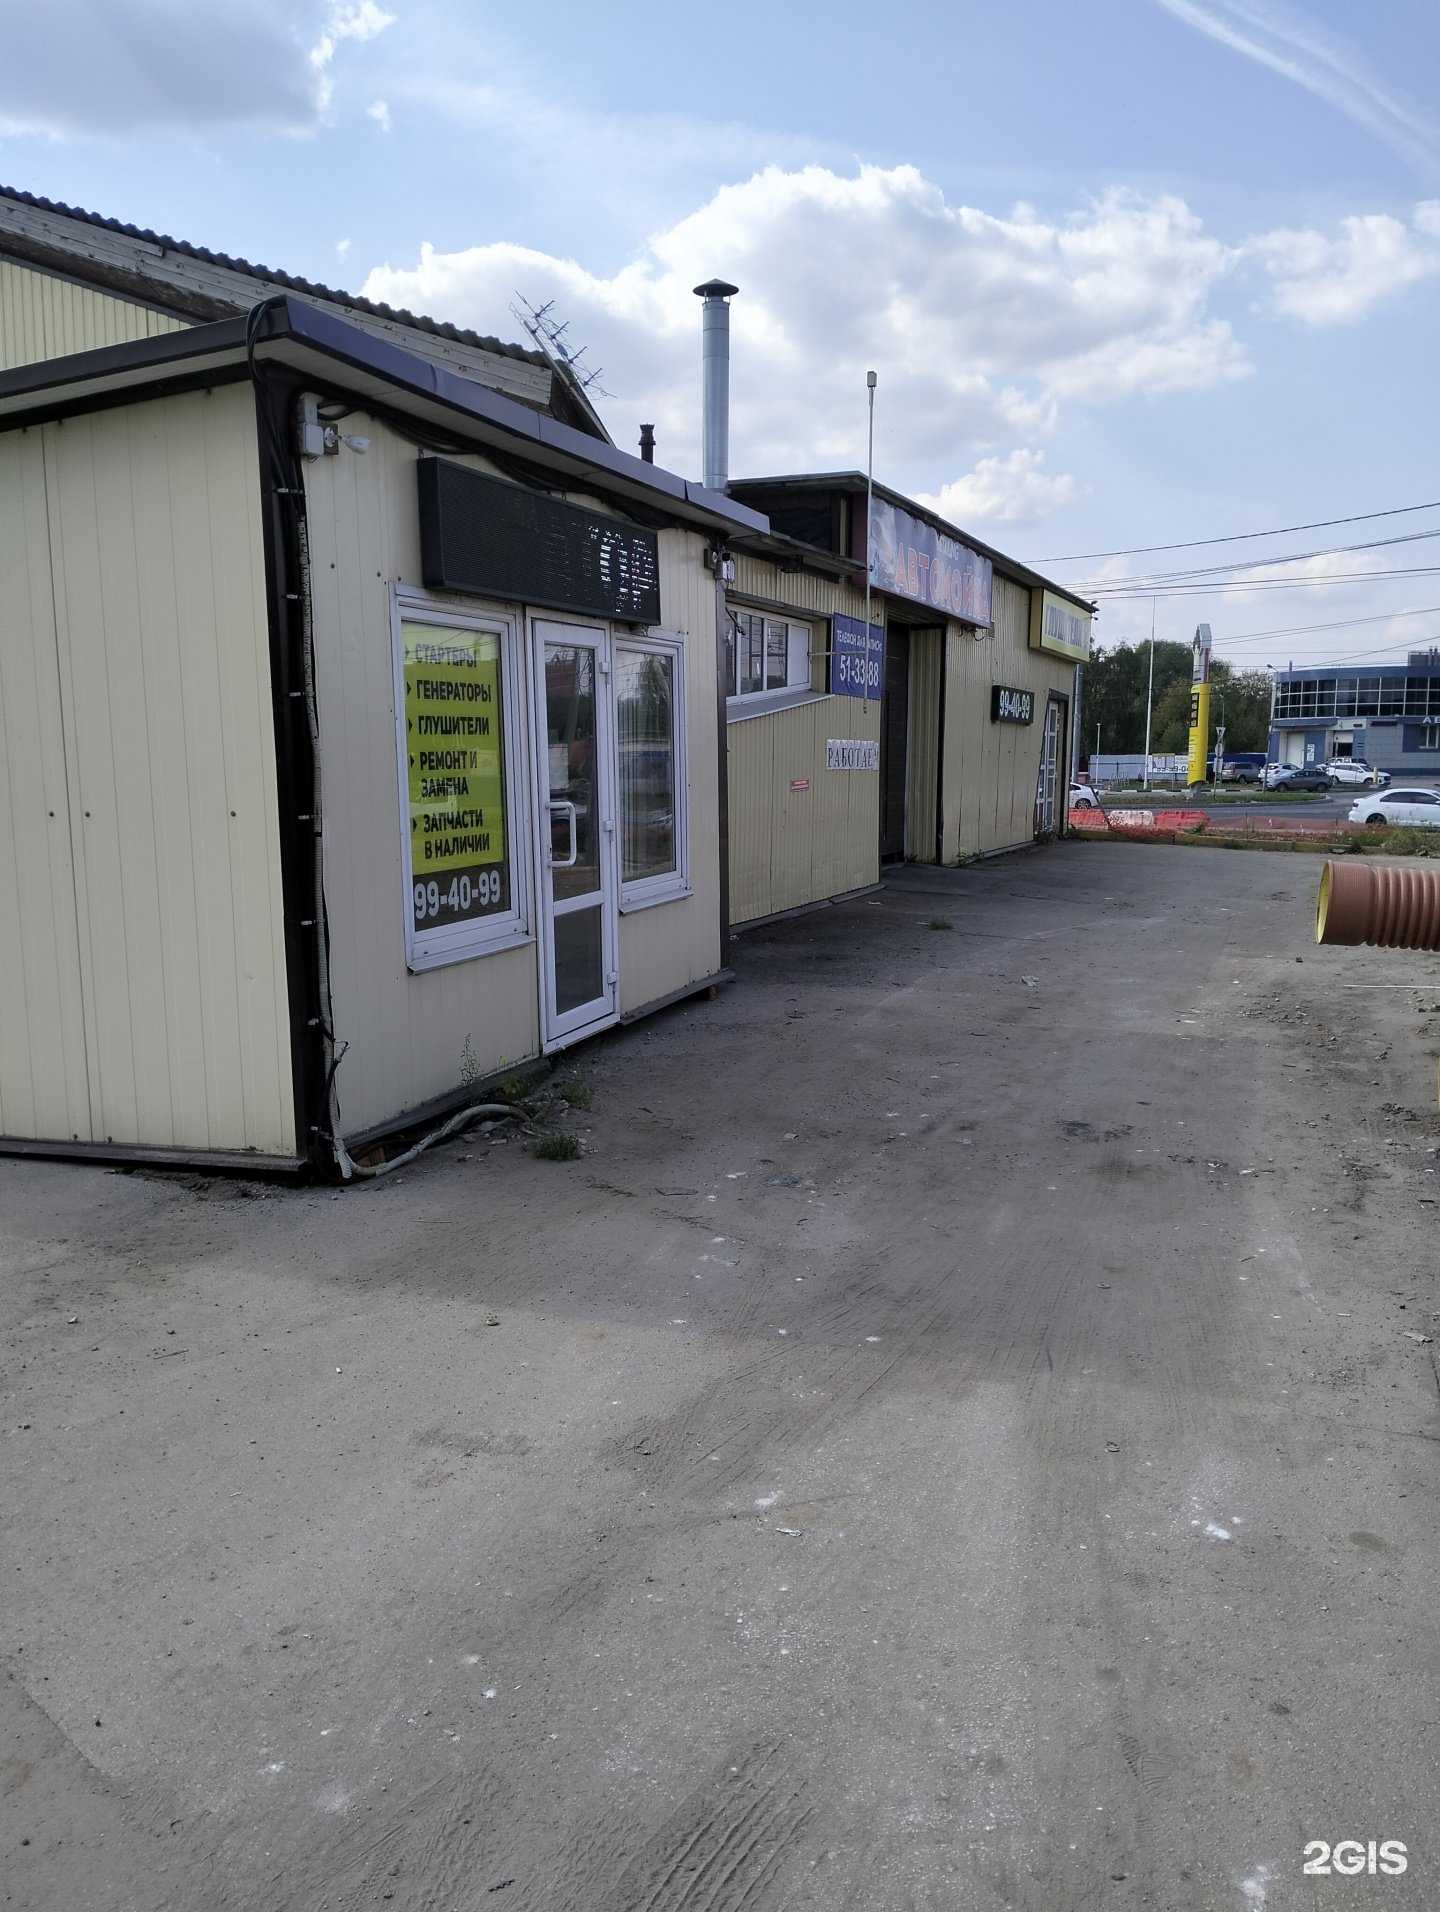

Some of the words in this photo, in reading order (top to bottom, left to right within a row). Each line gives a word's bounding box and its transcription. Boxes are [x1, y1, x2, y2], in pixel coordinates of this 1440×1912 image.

[414, 643, 477, 668] СТАРТЕРЫ
[416, 679, 492, 702] ГЕНЕРАТОРЫ
[999, 689, 1031, 719] 99-40-99
[418, 715, 490, 736] ГЛУШИТЕЛИ
[420, 750, 467, 770] РЕМОНТ
[469, 750, 478, 769] И
[421, 776, 469, 798] ЗАМЕНА
[423, 808, 483, 833] ЗАПЧАСТИ
[425, 840, 433, 860] В
[434, 833, 490, 858] НАЛИЧИИ
[413, 869, 501, 919] 99-40-99
